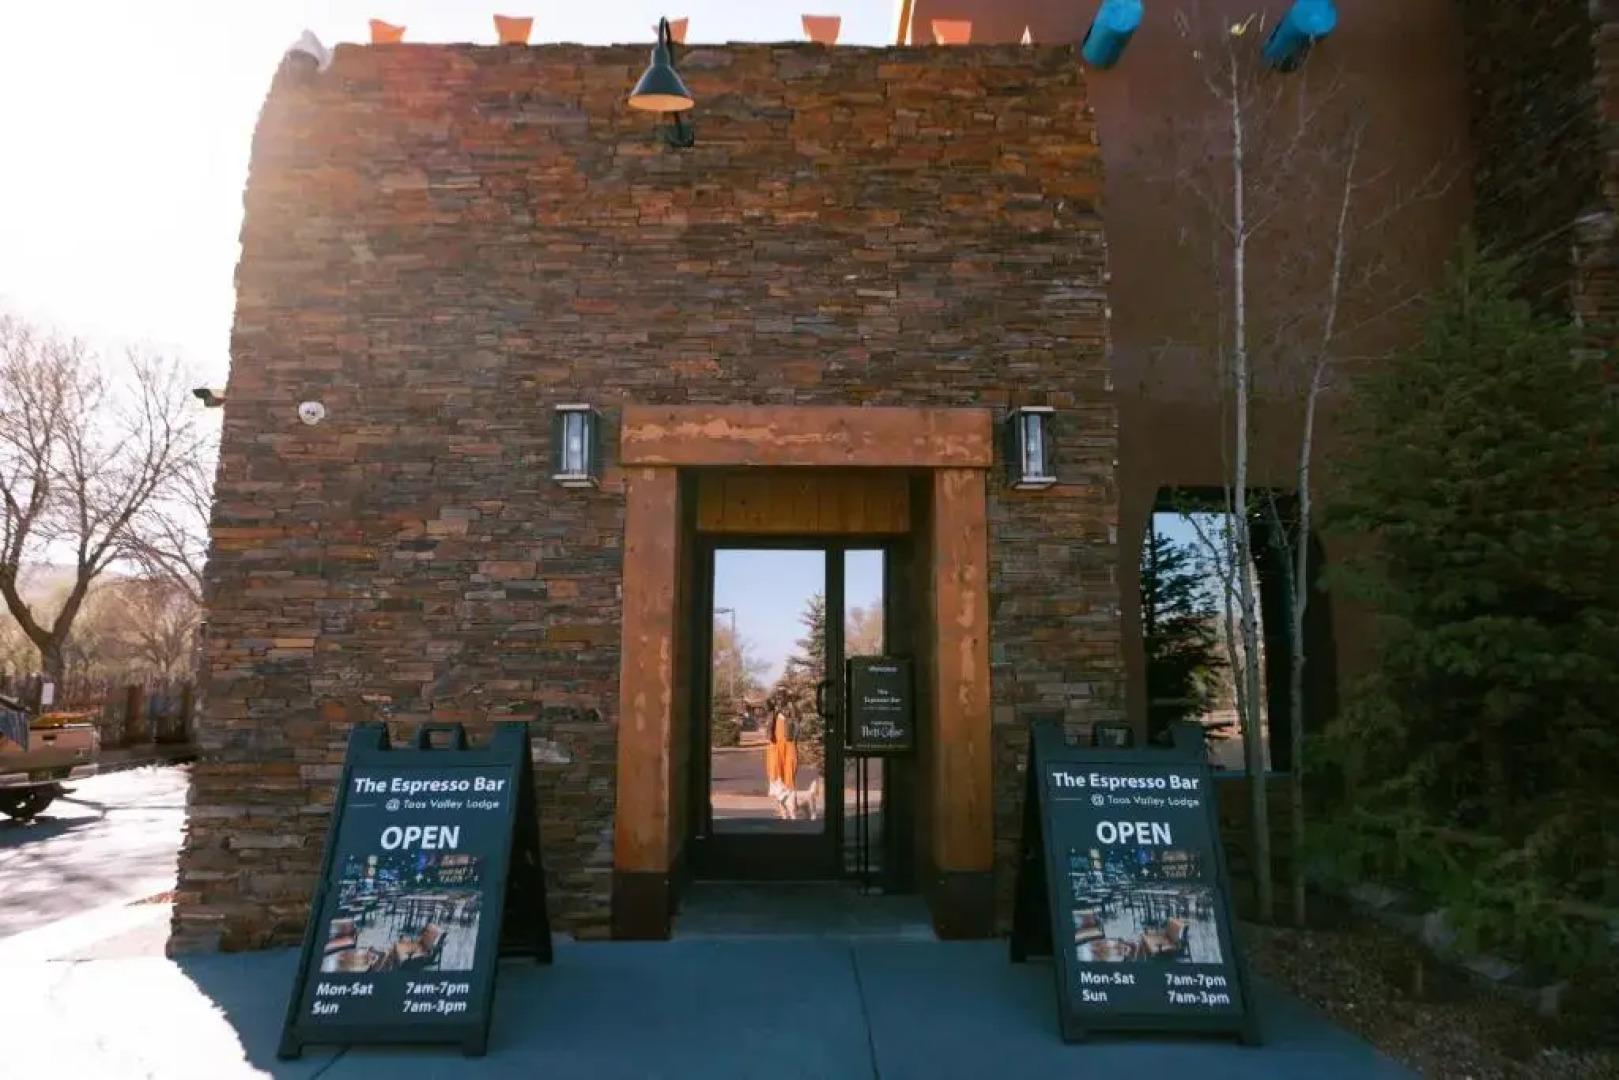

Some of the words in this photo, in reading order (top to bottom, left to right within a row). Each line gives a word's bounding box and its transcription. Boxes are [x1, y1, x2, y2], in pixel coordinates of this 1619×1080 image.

[354, 777, 388, 793] The
[391, 777, 471, 796] Espresso
[474, 777, 506, 792] Bar
[1052, 772, 1086, 787] The
[1090, 773, 1166, 791] Espresso
[1170, 775, 1200, 790] Bar
[385, 799, 401, 812] @
[404, 799, 427, 809] Taos
[431, 799, 463, 811] Valley
[466, 799, 500, 811] Lodge
[1091, 794, 1105, 806] @
[1107, 795, 1131, 804] Taos
[1134, 795, 1165, 807] Valley
[1168, 797, 1200, 808] Lodge
[380, 825, 461, 850] OPEN
[1096, 820, 1172, 846] OPEN
[1080, 972, 1136, 985] Mon-Sat
[1165, 973, 1227, 989] 7am-7pm
[316, 982, 374, 996] Mon-Sat
[406, 981, 470, 998] 7am-7pm
[1082, 989, 1108, 1003] Sun
[1167, 990, 1230, 1007] 7am-3pm
[311, 1001, 340, 1015] Sun
[402, 1000, 467, 1016] 7am-3pm
